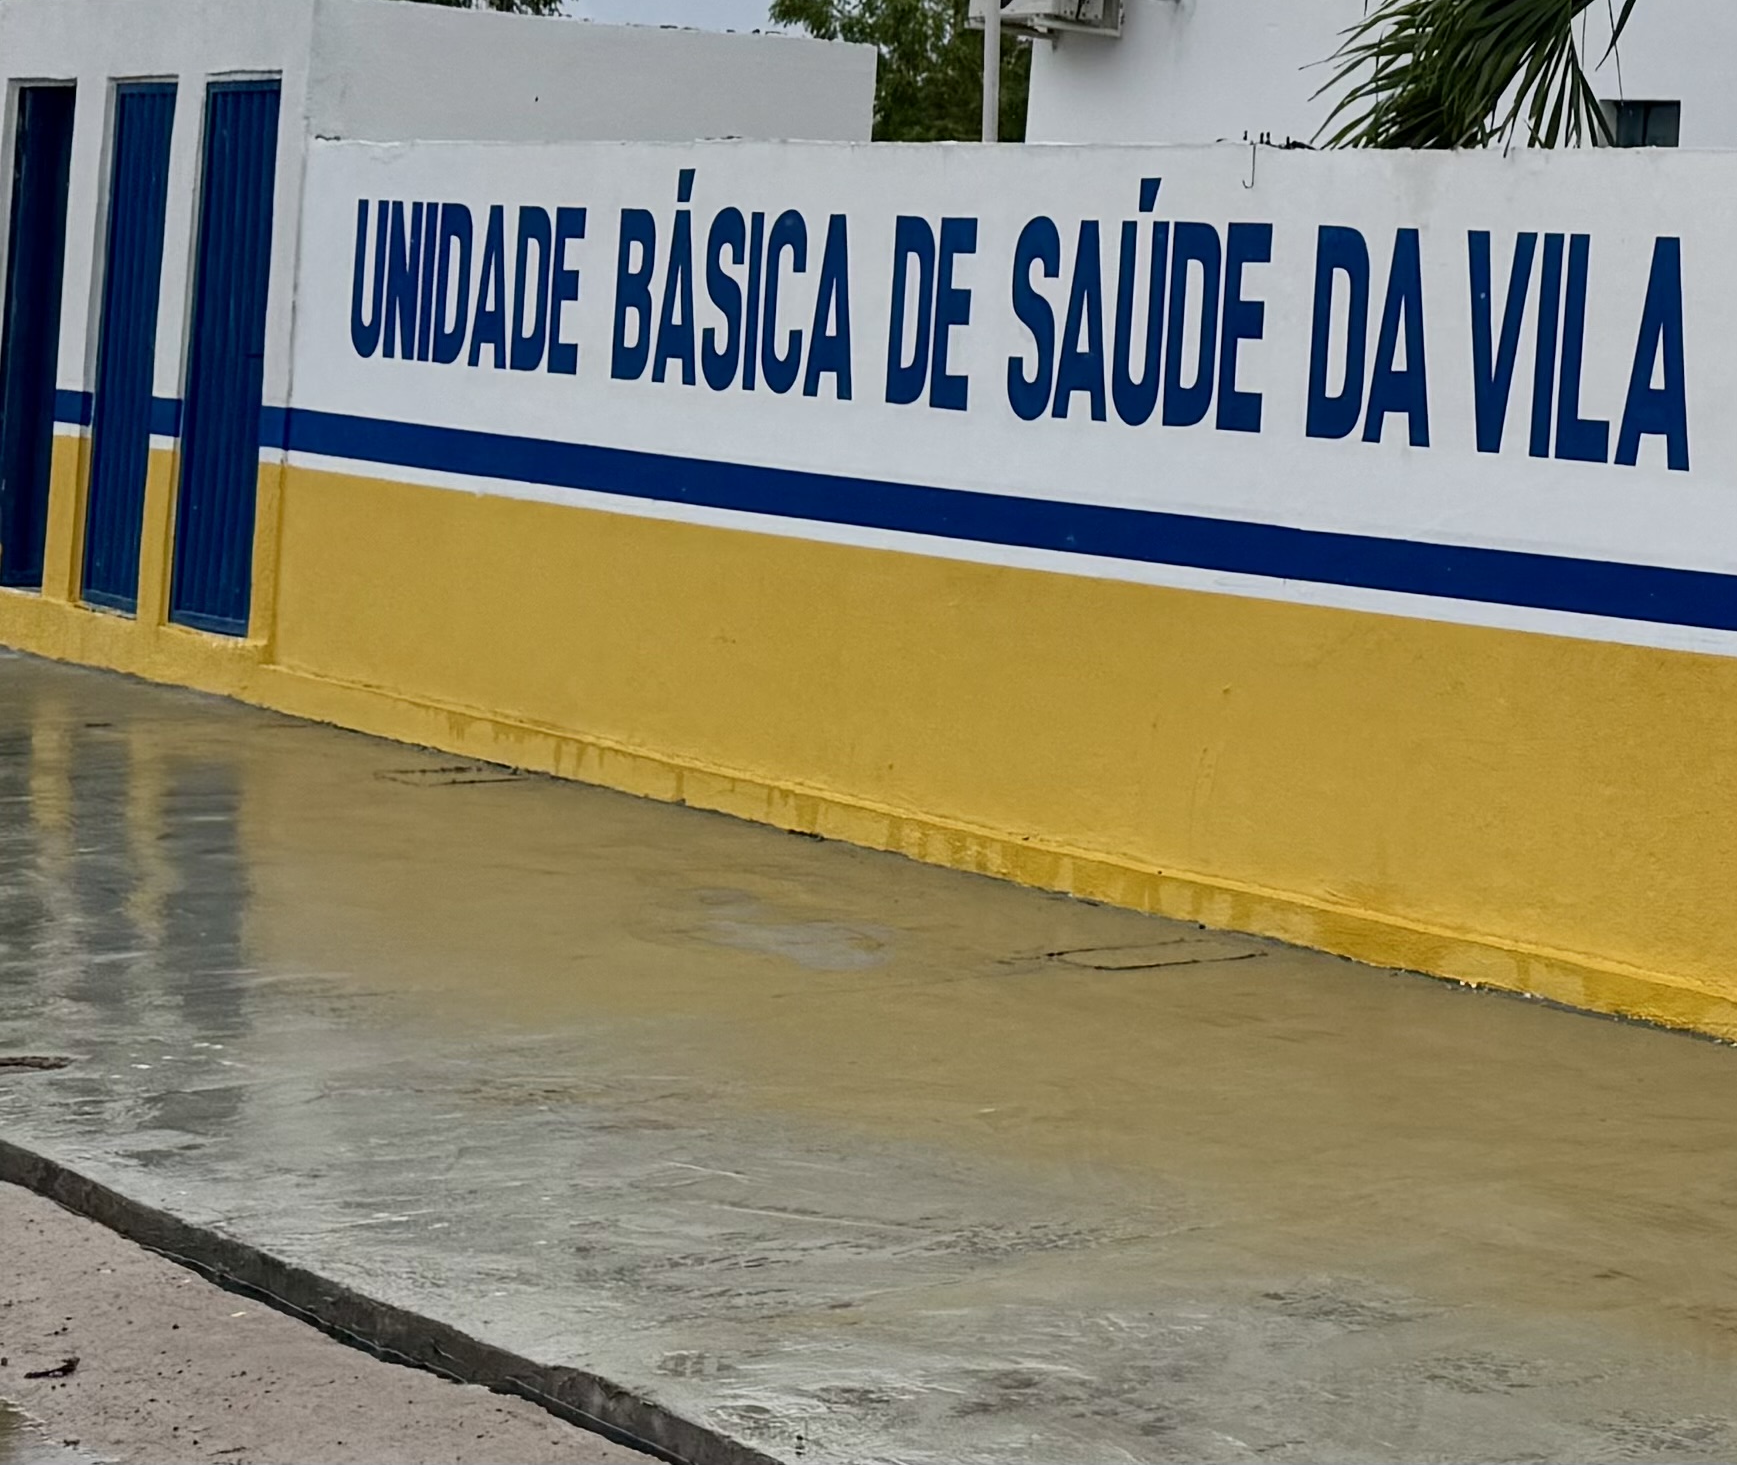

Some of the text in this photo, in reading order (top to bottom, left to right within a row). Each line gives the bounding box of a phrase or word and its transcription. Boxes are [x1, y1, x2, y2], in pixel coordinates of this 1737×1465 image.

[350, 198, 588, 375] UNIDADE
[610, 168, 853, 400] BÁSICA
[885, 215, 978, 411] DE
[1006, 177, 1273, 433] SAÚDE
[1306, 224, 1431, 447] DA
[1468, 230, 1690, 472] VILA
